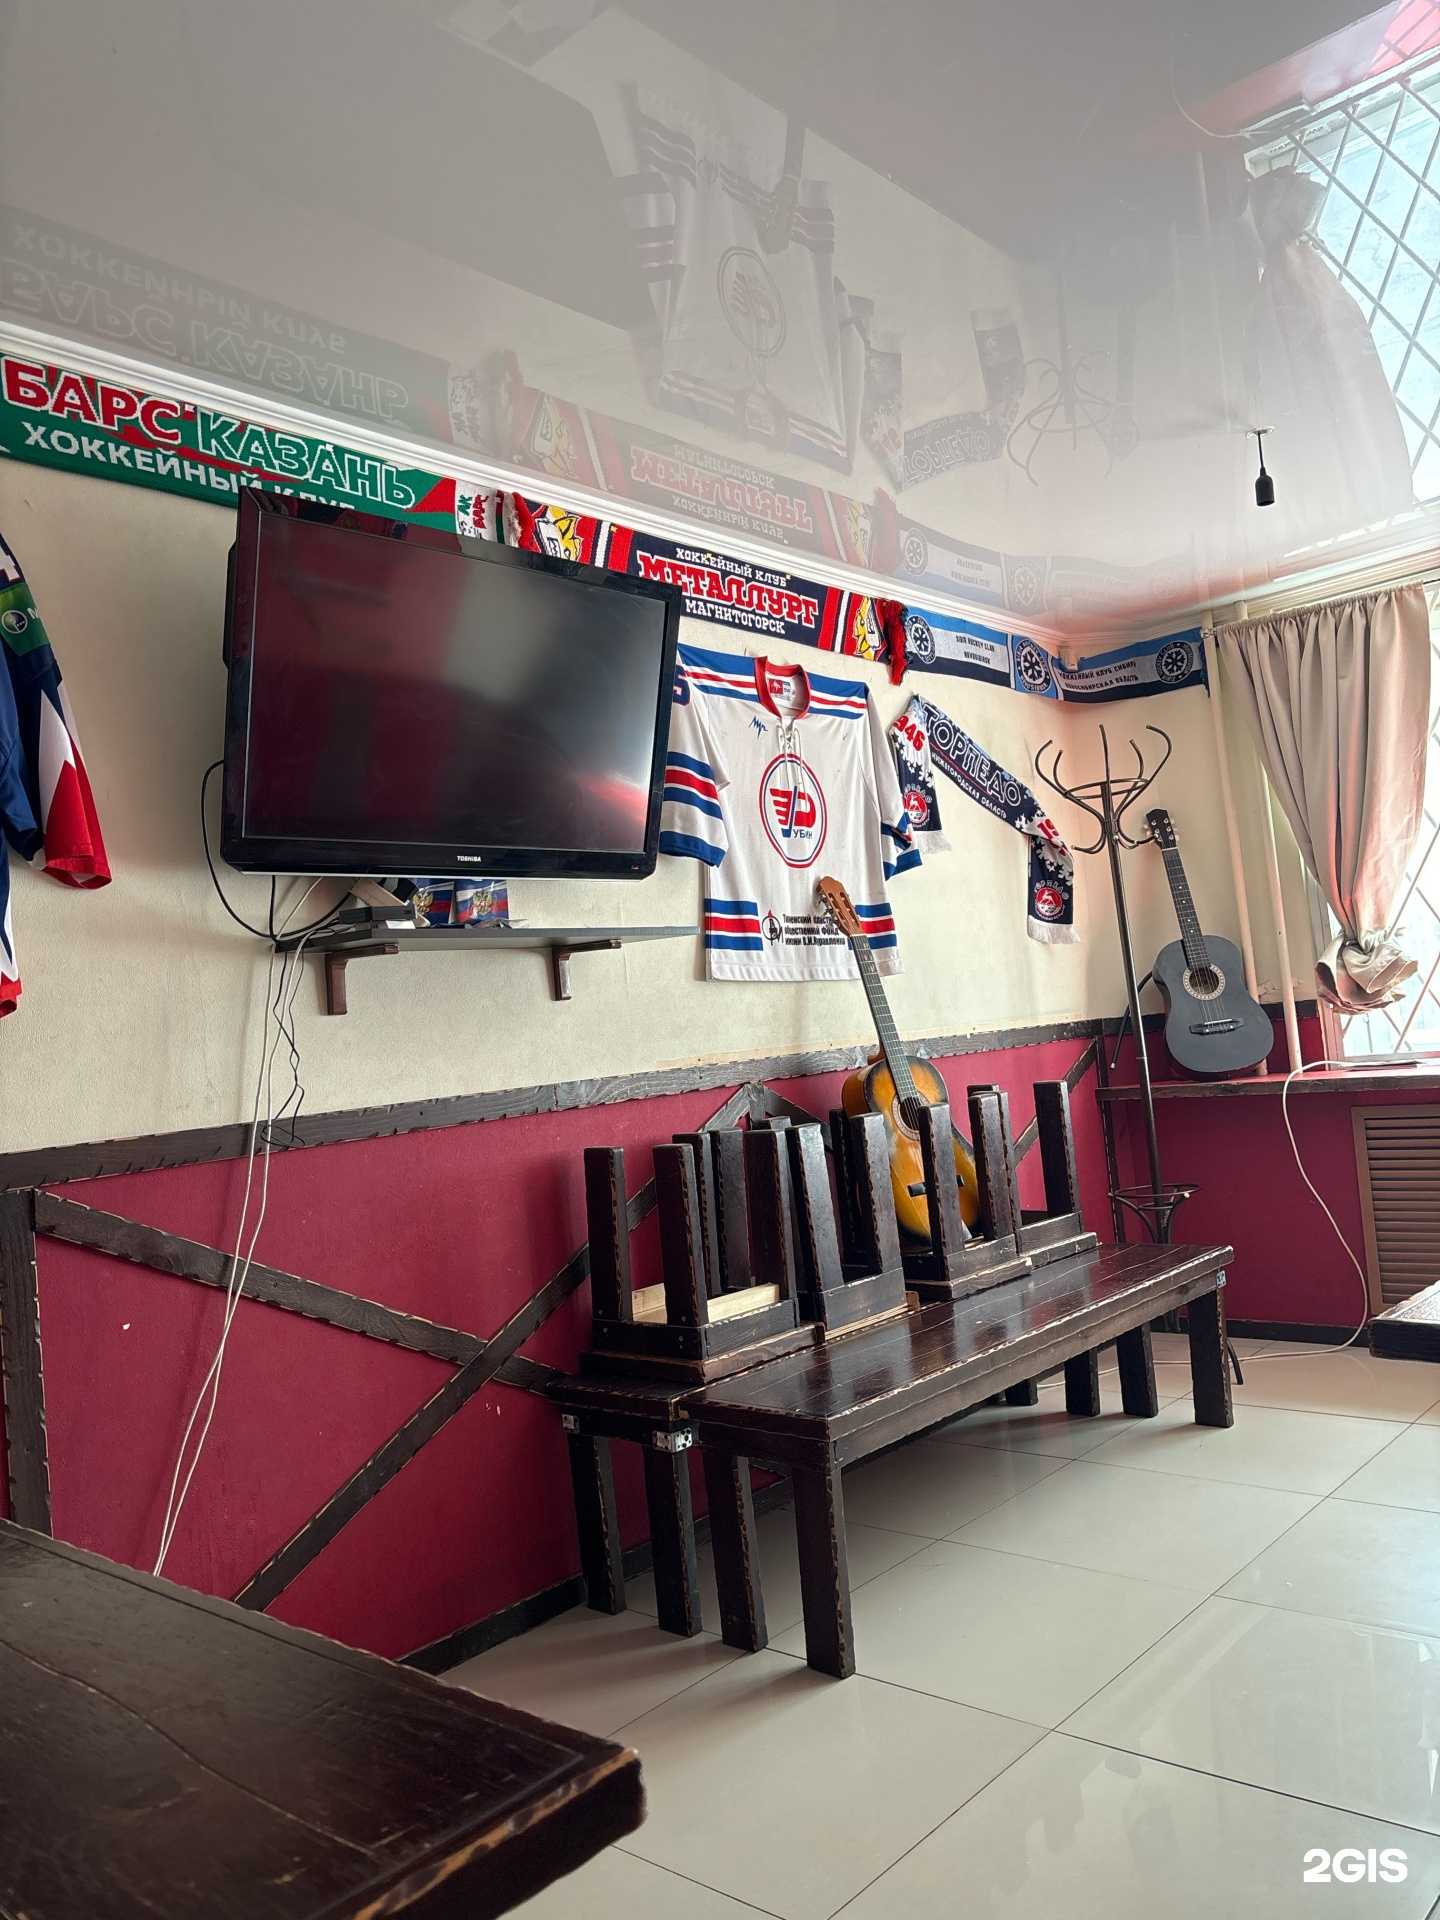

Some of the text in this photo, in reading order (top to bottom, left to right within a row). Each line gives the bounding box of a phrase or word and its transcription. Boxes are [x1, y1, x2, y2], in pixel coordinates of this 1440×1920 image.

[1, 356, 416, 509] БАРС КАЗАНЬ
[21, 421, 263, 494] ХОККЕЙНЫЙ
[636, 549, 819, 629] МЕТАЛЛУРГ
[676, 547, 787, 587] ХОККЕЙНЫЙ КЛУБ
[685, 598, 786, 634] МАГНИТОГОРСК
[922, 703, 1022, 807] ТОРПЕДО
